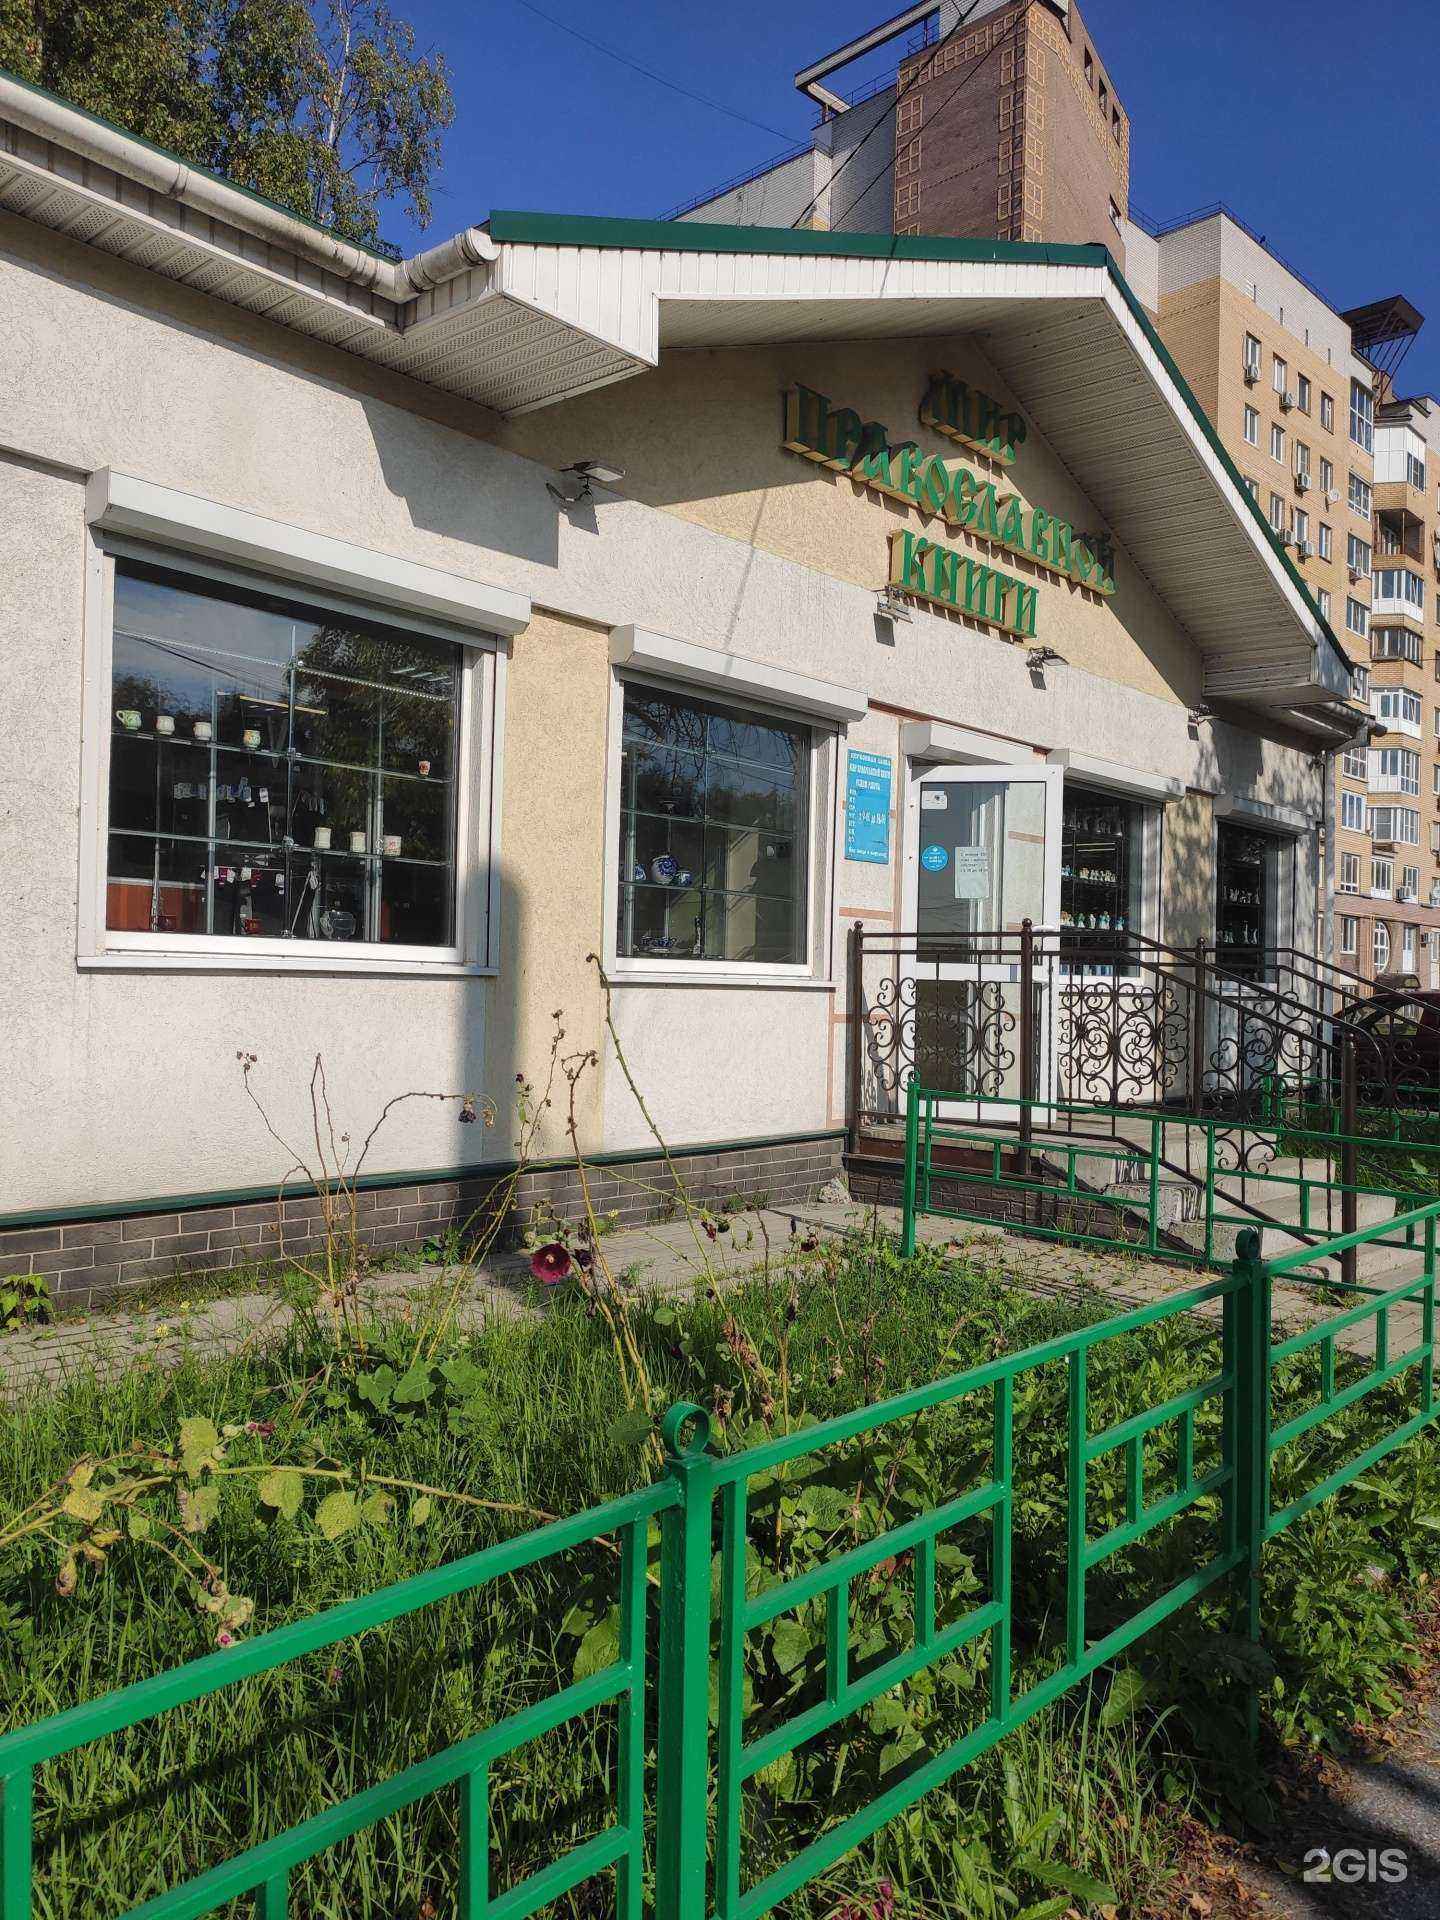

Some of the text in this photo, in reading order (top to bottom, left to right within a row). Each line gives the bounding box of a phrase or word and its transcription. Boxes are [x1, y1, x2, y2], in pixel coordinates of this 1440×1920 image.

[922, 370, 1026, 465] МИР
[783, 383, 1114, 596] ПРАВОСЛАВНОЙ
[889, 529, 1039, 638] КНИГИ
